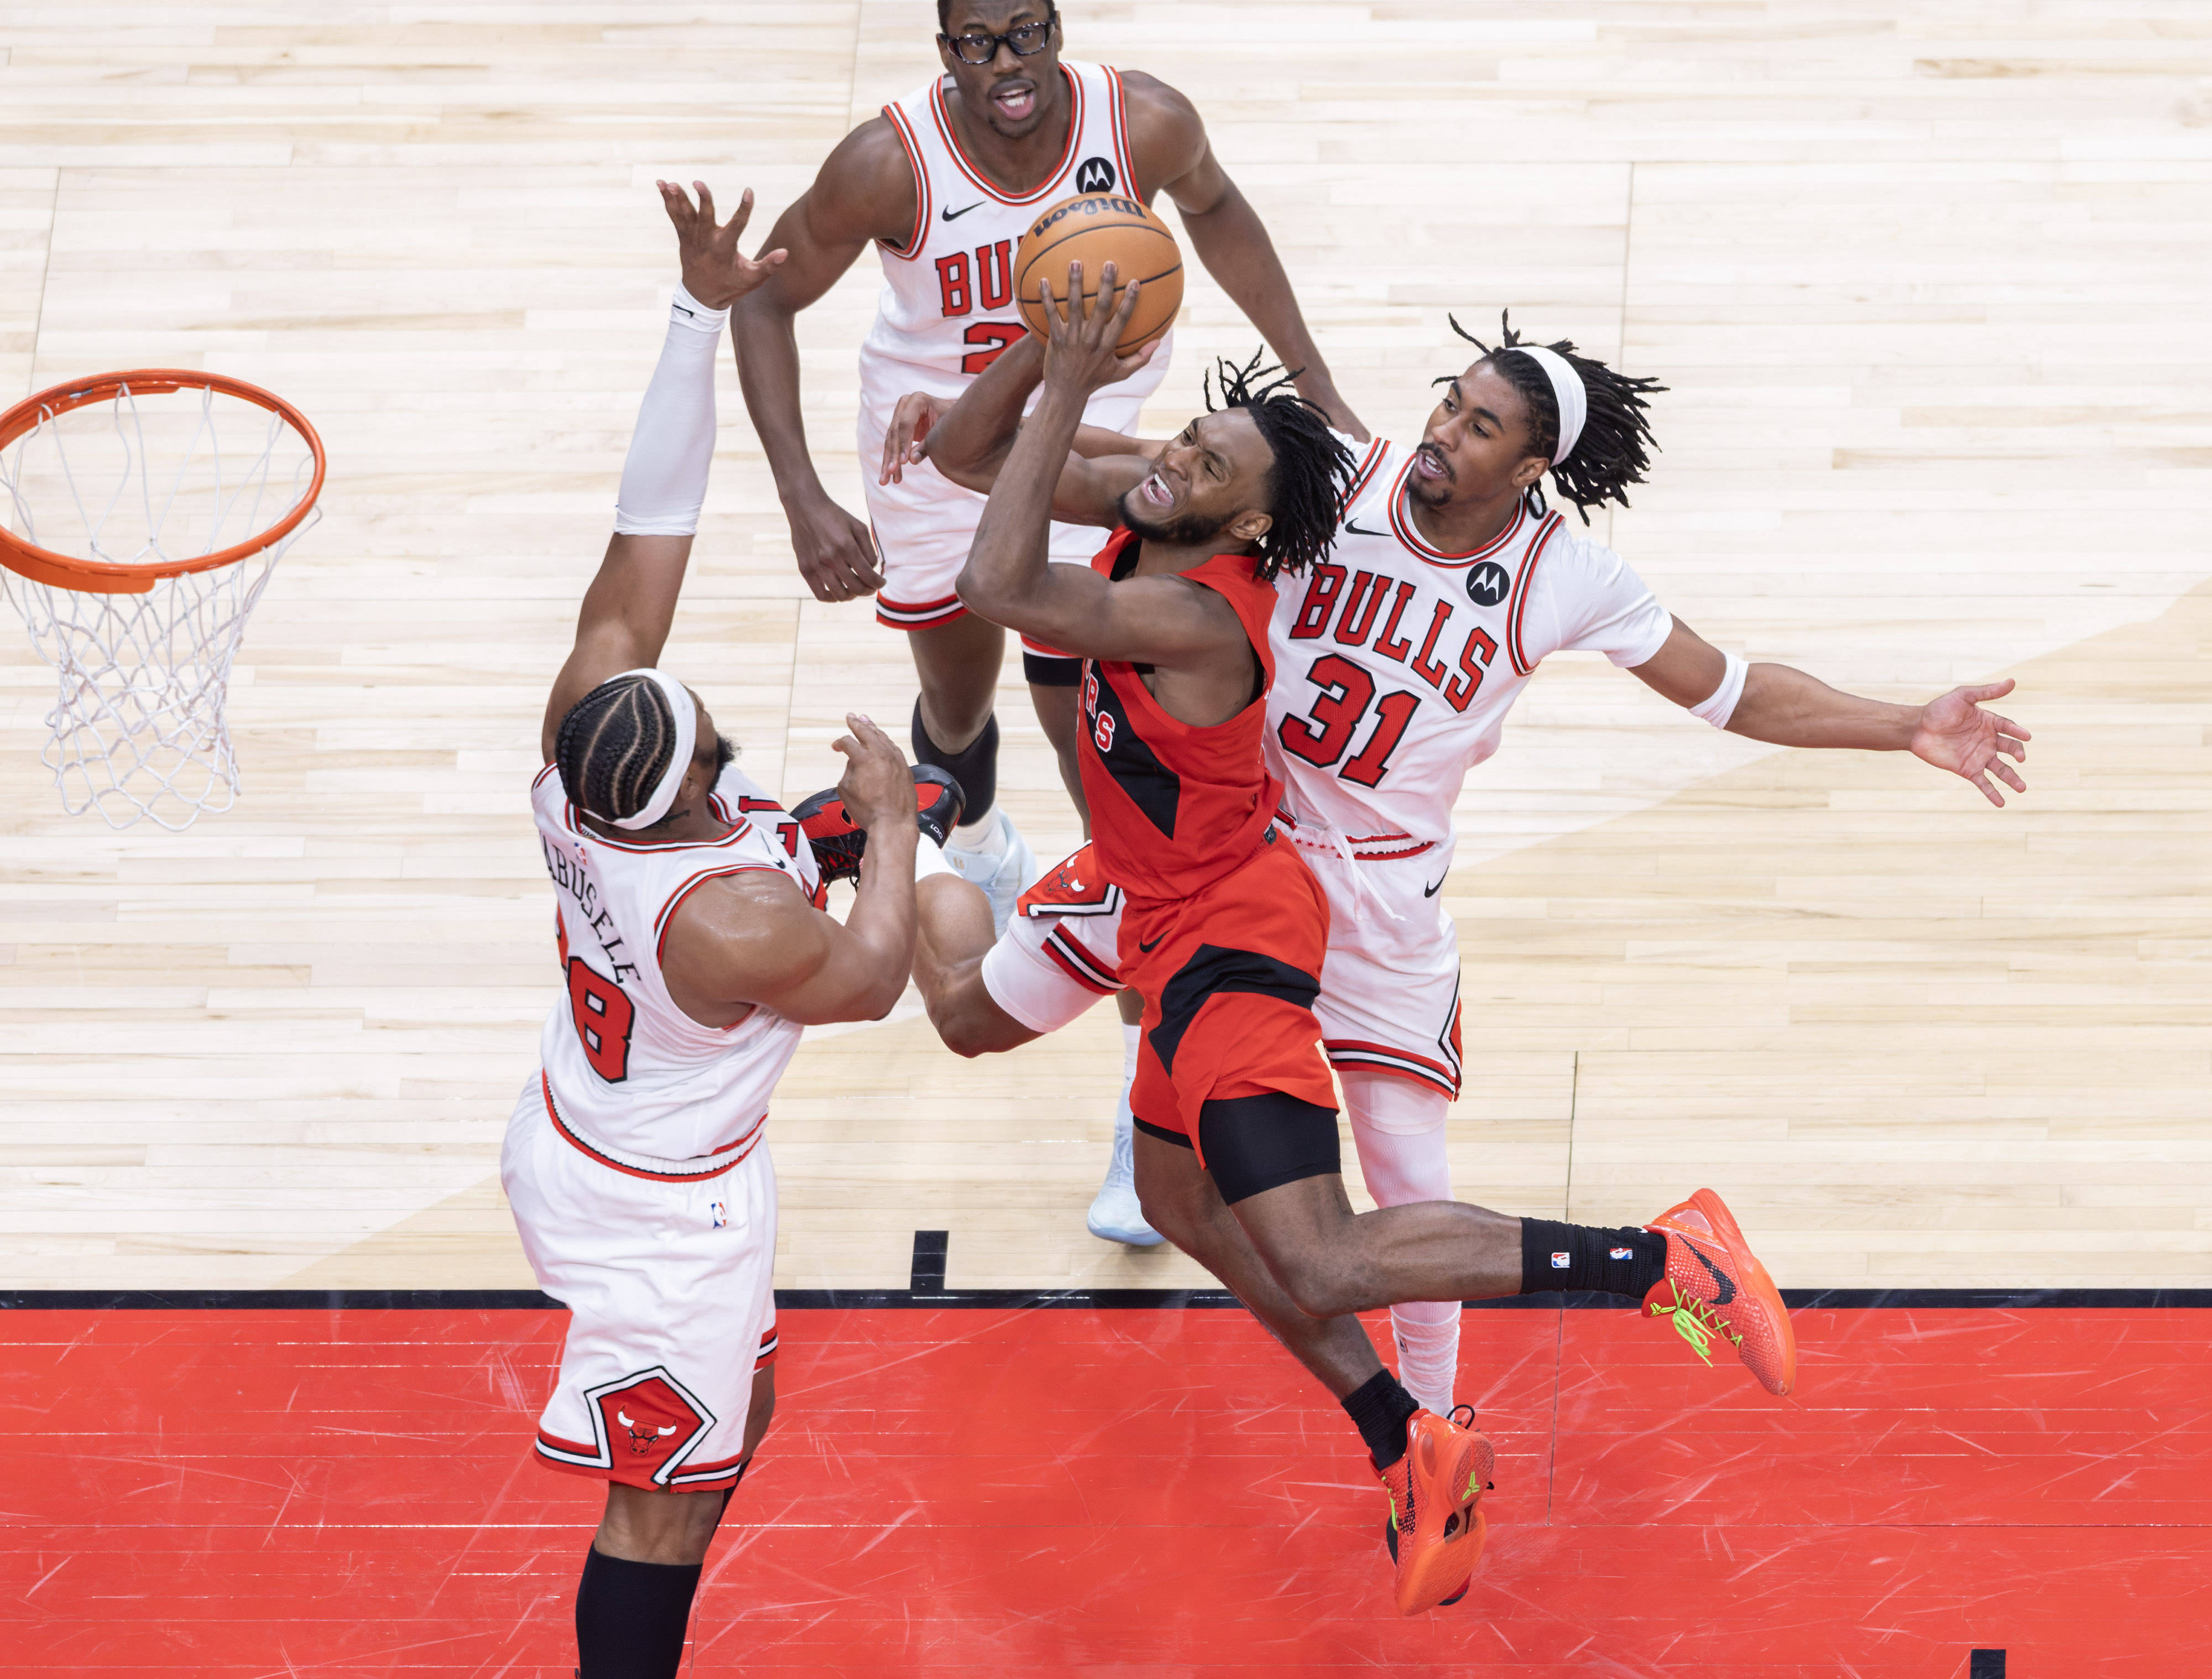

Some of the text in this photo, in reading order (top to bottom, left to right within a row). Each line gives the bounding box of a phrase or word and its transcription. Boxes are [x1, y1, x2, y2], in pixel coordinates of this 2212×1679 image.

[935, 236, 1025, 318] BU
[1034, 197, 1147, 237] Wilson
[1289, 564, 1499, 714] BULLS
[1277, 653, 1422, 789] 31
[557, 899, 635, 1083] 8
